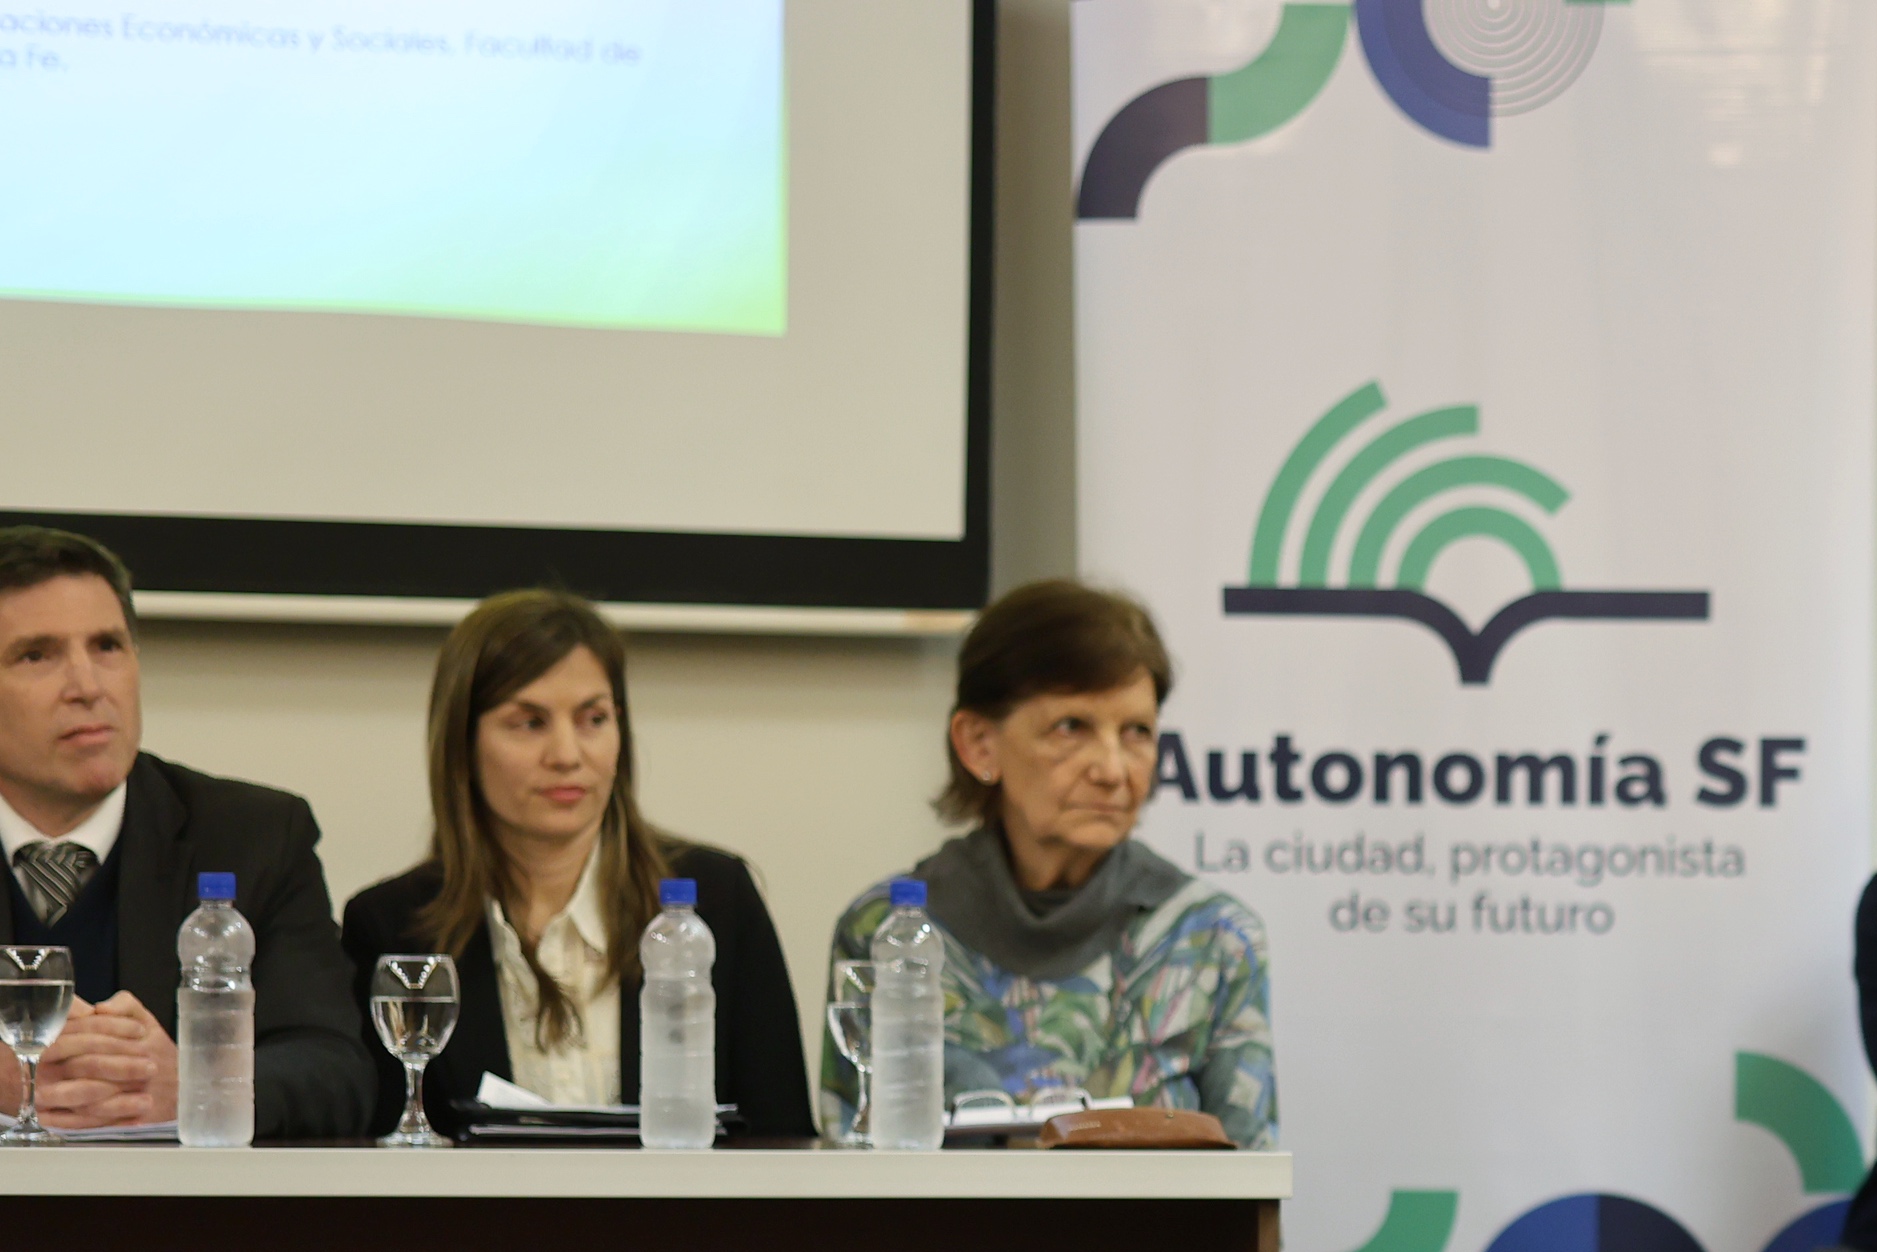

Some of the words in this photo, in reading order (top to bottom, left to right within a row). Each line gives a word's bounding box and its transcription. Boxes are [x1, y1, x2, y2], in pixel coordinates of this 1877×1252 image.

[308, 30, 324, 54] y
[600, 39, 643, 66] de
[1156, 732, 1668, 806] Autonomía
[1694, 737, 1807, 807] SF
[1194, 834, 1250, 874] La
[1263, 833, 1437, 882] ciudad,
[1449, 836, 1745, 886] protagonista
[1329, 893, 1391, 932] de
[1405, 902, 1458, 932] su
[1470, 893, 1616, 935] futuro
